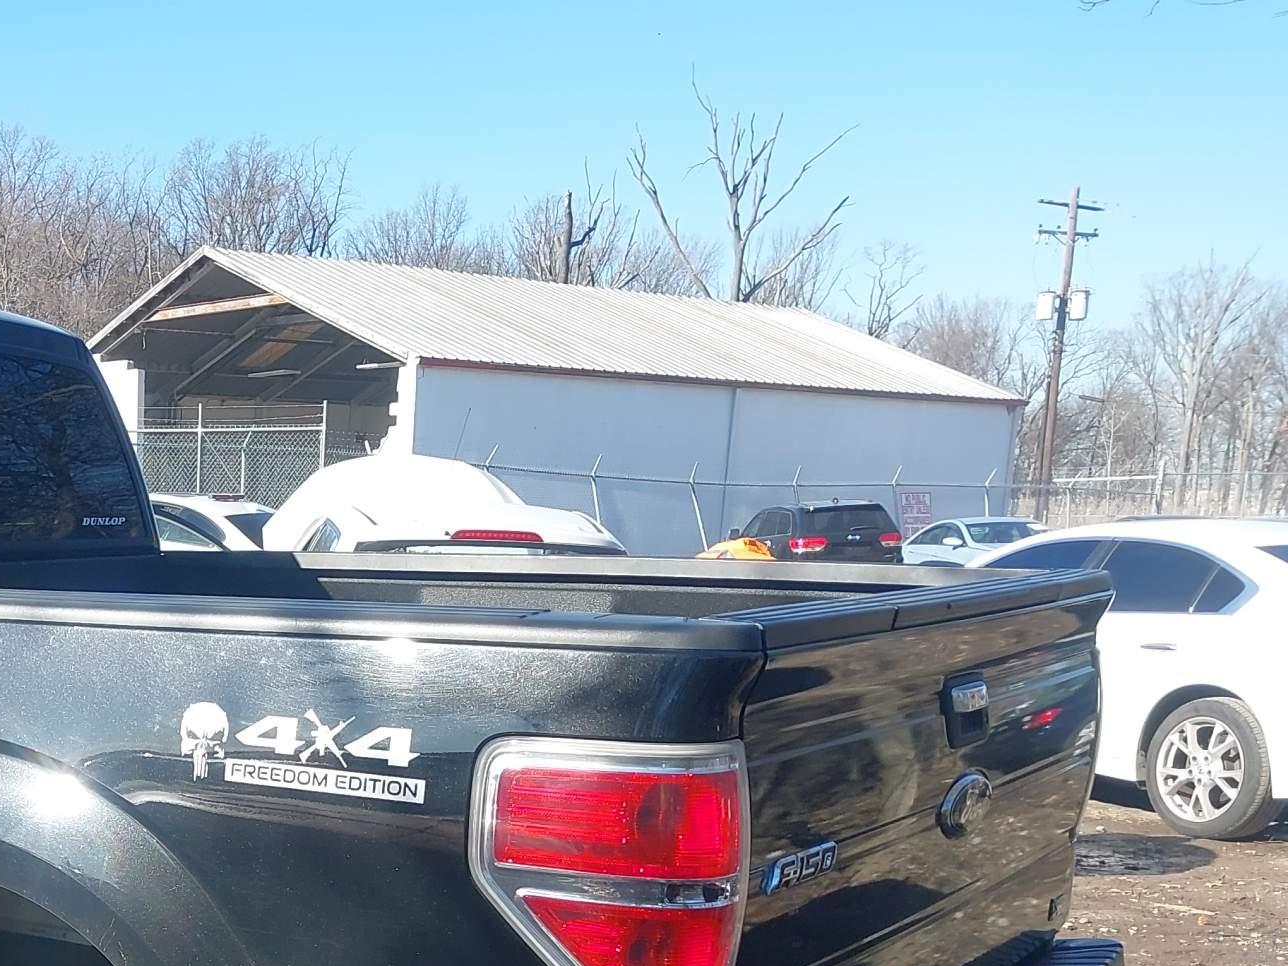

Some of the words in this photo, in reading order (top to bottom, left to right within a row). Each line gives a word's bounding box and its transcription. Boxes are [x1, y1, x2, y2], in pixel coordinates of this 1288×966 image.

[82, 516, 126, 526] DUNLOP
[230, 763, 328, 788] FREEDOM
[334, 775, 419, 799] EDITION
